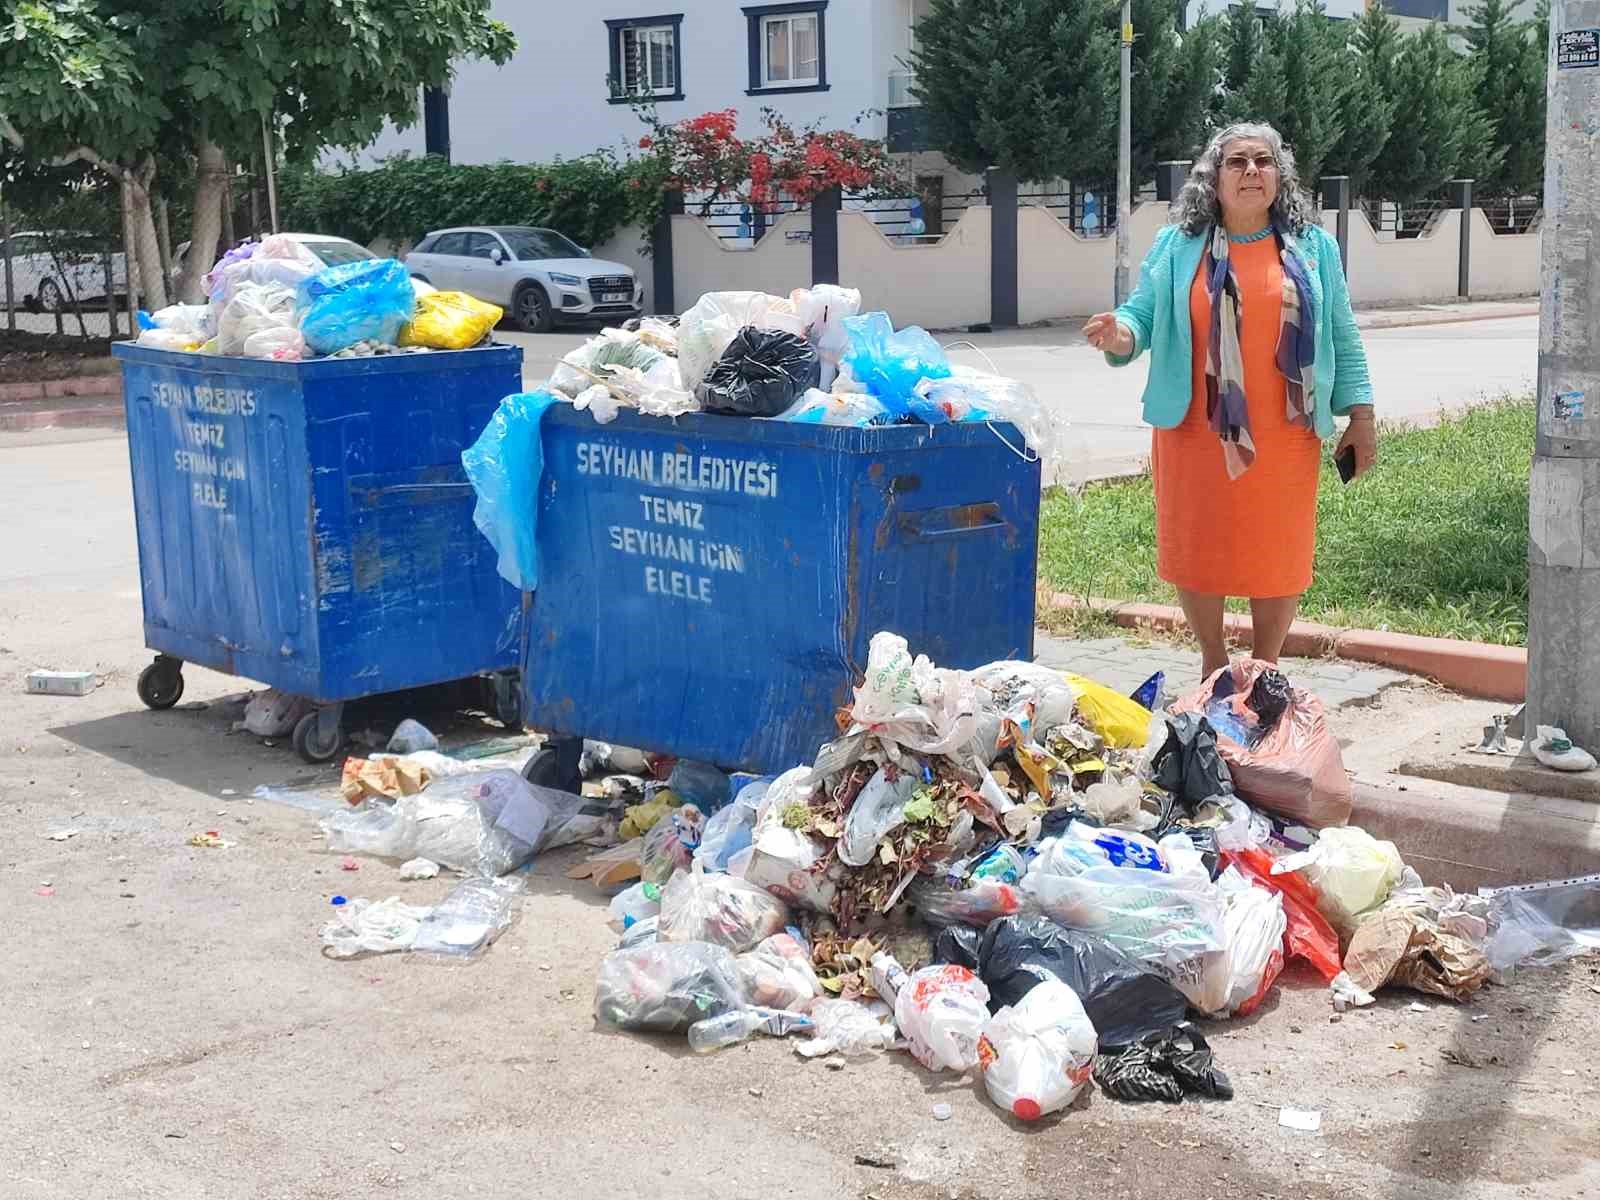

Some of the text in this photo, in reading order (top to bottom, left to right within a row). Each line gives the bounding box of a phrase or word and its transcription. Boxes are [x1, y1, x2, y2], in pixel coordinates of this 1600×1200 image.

[576, 442, 654, 483] SEYHAN
[608, 525, 695, 564] SEYHAN
[644, 566, 713, 603] ELELE
